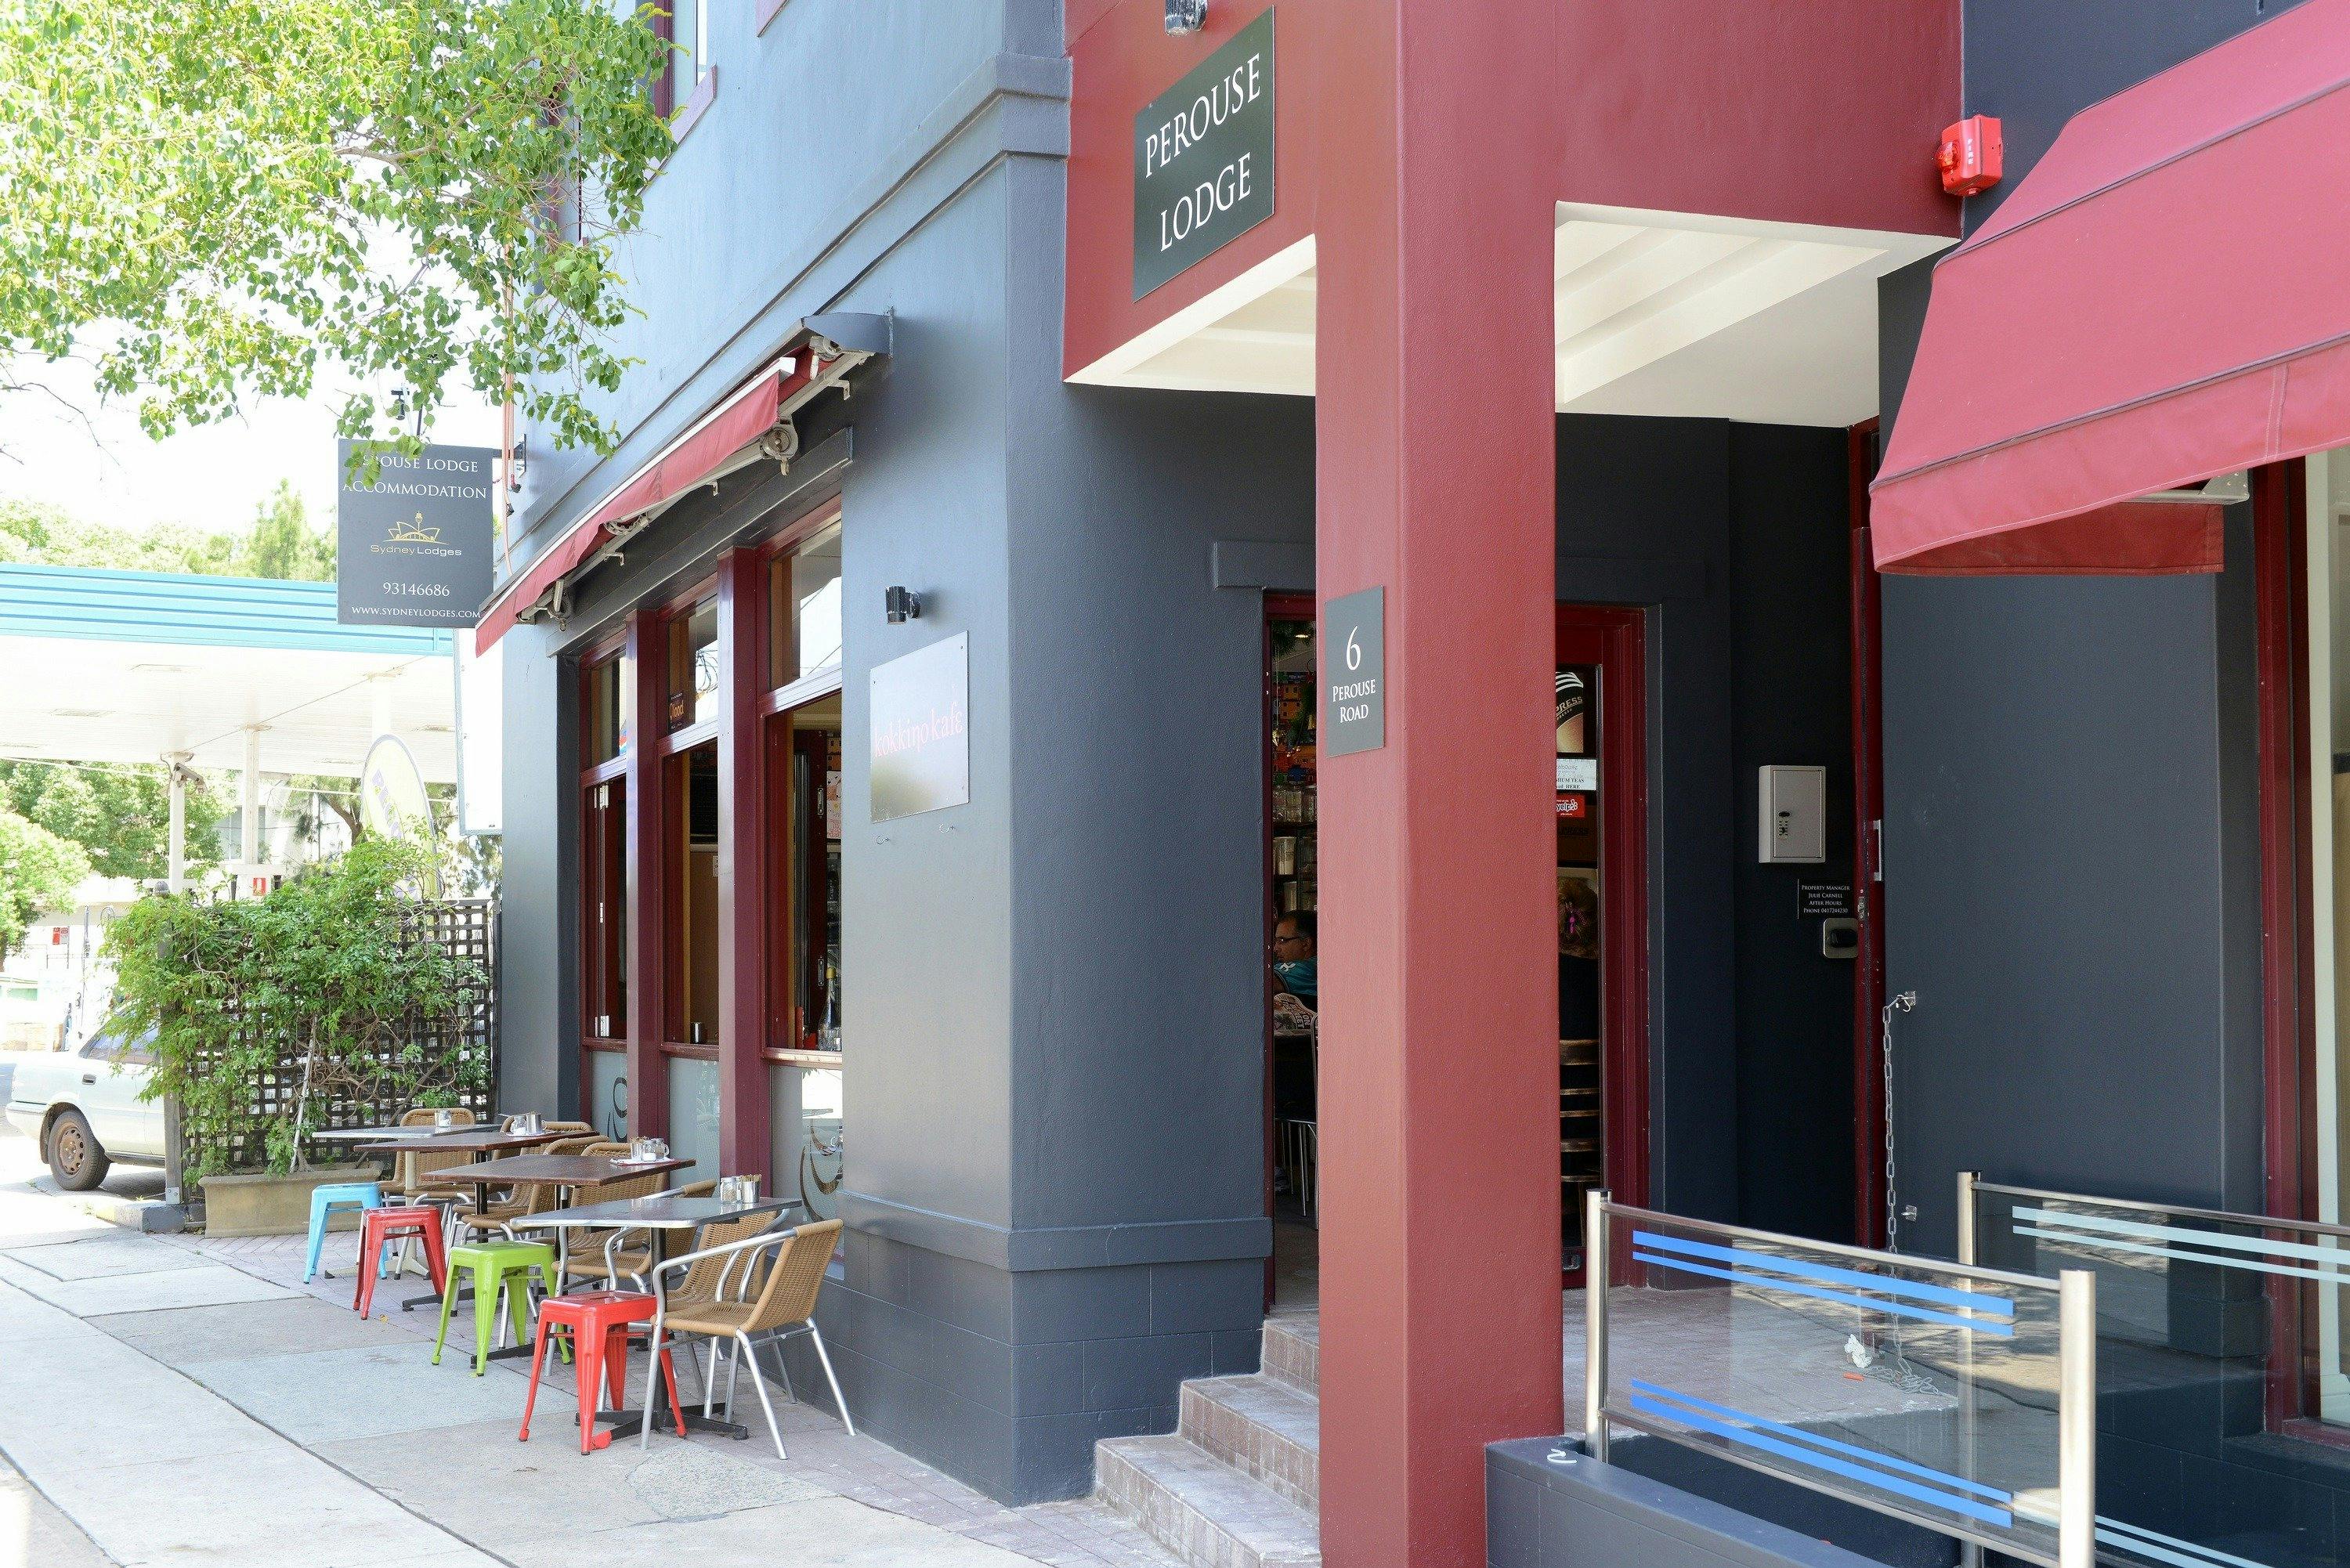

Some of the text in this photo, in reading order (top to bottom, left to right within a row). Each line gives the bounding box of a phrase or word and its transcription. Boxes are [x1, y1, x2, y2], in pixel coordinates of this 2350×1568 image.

[1145, 52, 1260, 179] PEROUSE
[1160, 151, 1251, 252] LODGE
[426, 458, 479, 472] LODGE
[342, 480, 486, 499] ACCOMMODATION
[370, 544, 462, 557] Sydney Lodges
[383, 581, 450, 597] 93146686
[351, 606, 480, 618] WWW.SYDNEYLODGES.COM
[1346, 625, 1361, 671] 6
[1332, 678, 1376, 703] PEROUSE
[1340, 704, 1369, 723] ROAD
[1556, 803, 1571, 812] yelp
